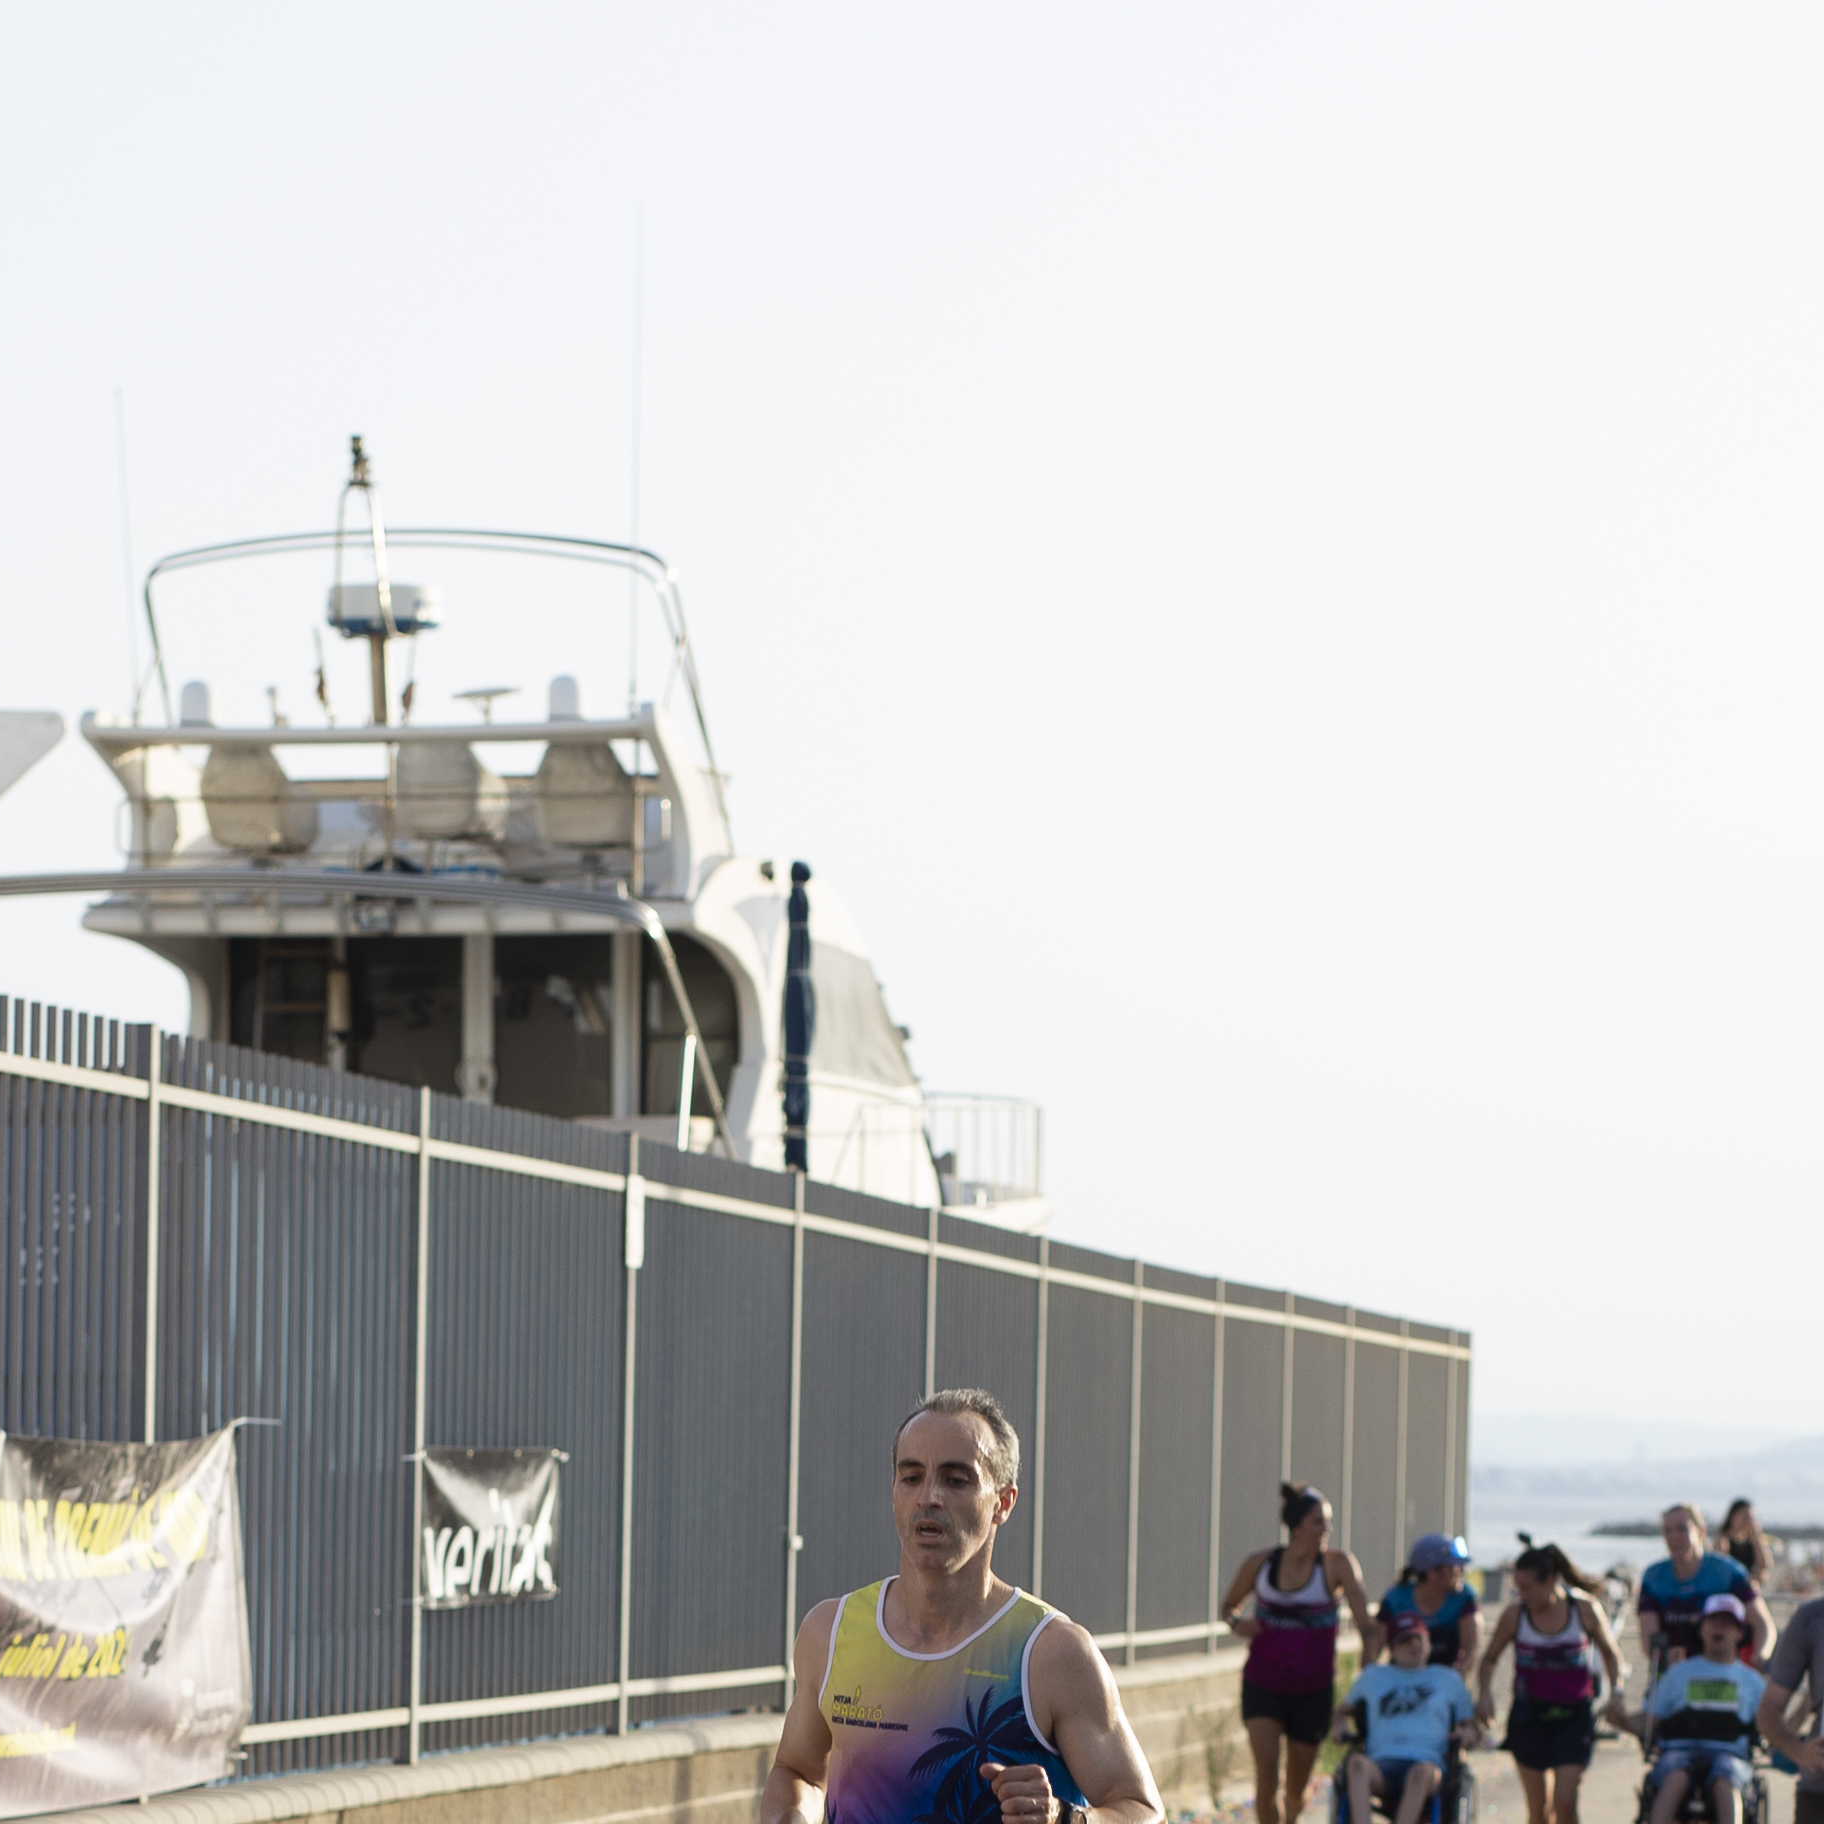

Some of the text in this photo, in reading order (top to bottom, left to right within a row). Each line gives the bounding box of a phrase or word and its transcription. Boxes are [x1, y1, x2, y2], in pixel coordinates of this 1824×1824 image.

[57, 1631, 89, 1680] de
[86, 1626, 134, 1680] 202
[832, 1704, 884, 1720] MARATÓ
